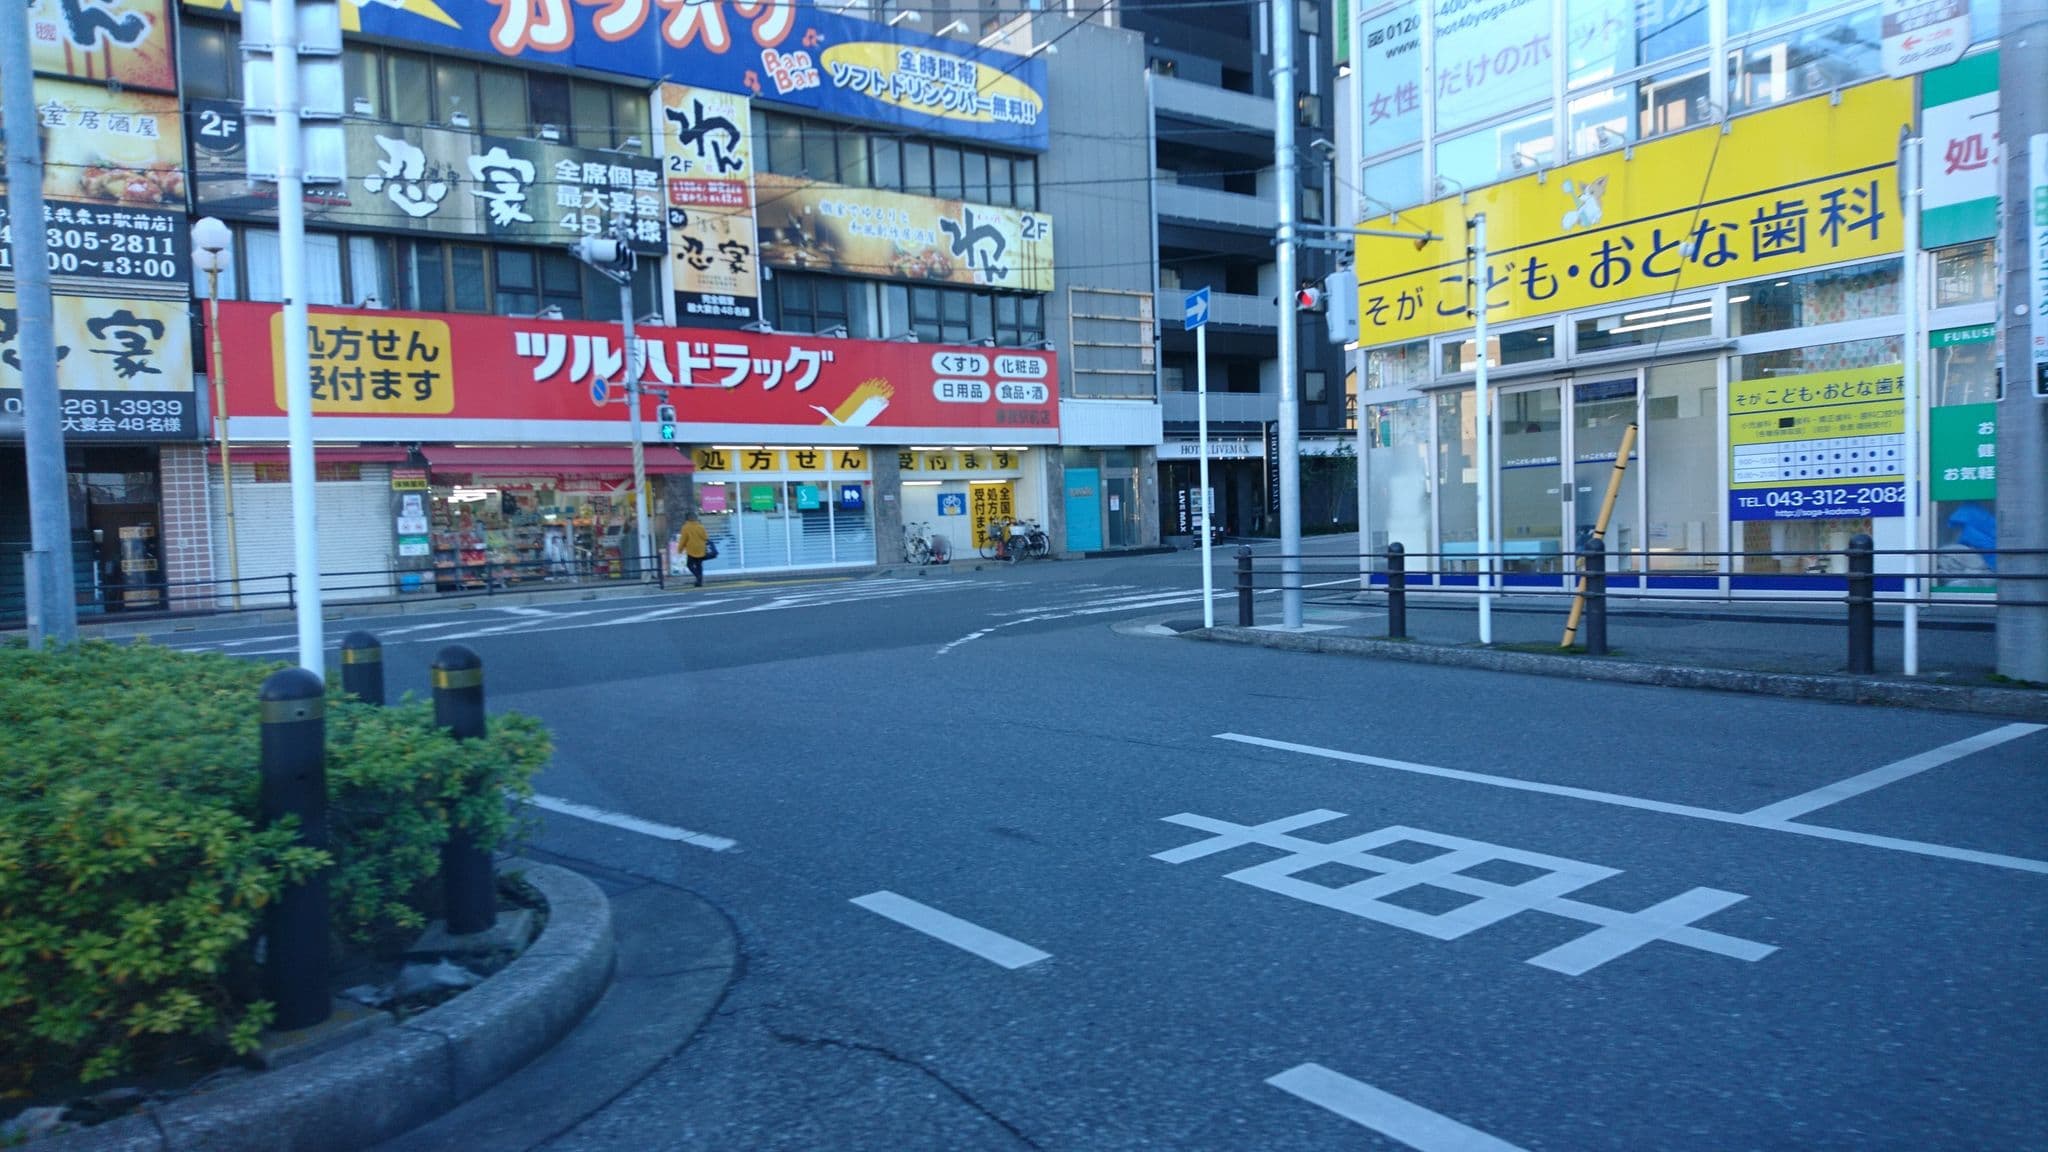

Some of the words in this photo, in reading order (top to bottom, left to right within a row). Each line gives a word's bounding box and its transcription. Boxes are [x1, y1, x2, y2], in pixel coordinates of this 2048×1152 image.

[899, 49, 978, 89] 全時間帯
[200, 110, 238, 138] 2F
[670, 155, 693, 173] 2F
[1944, 133, 2000, 175] 処
[554, 159, 659, 192] 全席個室
[556, 184, 660, 217] 最大宴会
[1020, 214, 1049, 241] 2F
[514, 331, 835, 392] ツルハドラッグ
[940, 355, 981, 373] くすり
[1001, 359, 1041, 374] 化粧品
[943, 383, 983, 399] 日用品
[1001, 384, 1043, 400] 食品・酒
[4, 397, 183, 416] 0-261-3939
[700, 450, 861, 471] 処方せん
[1178, 490, 1187, 511] LIVE
[1179, 511, 1188, 533] MAX
